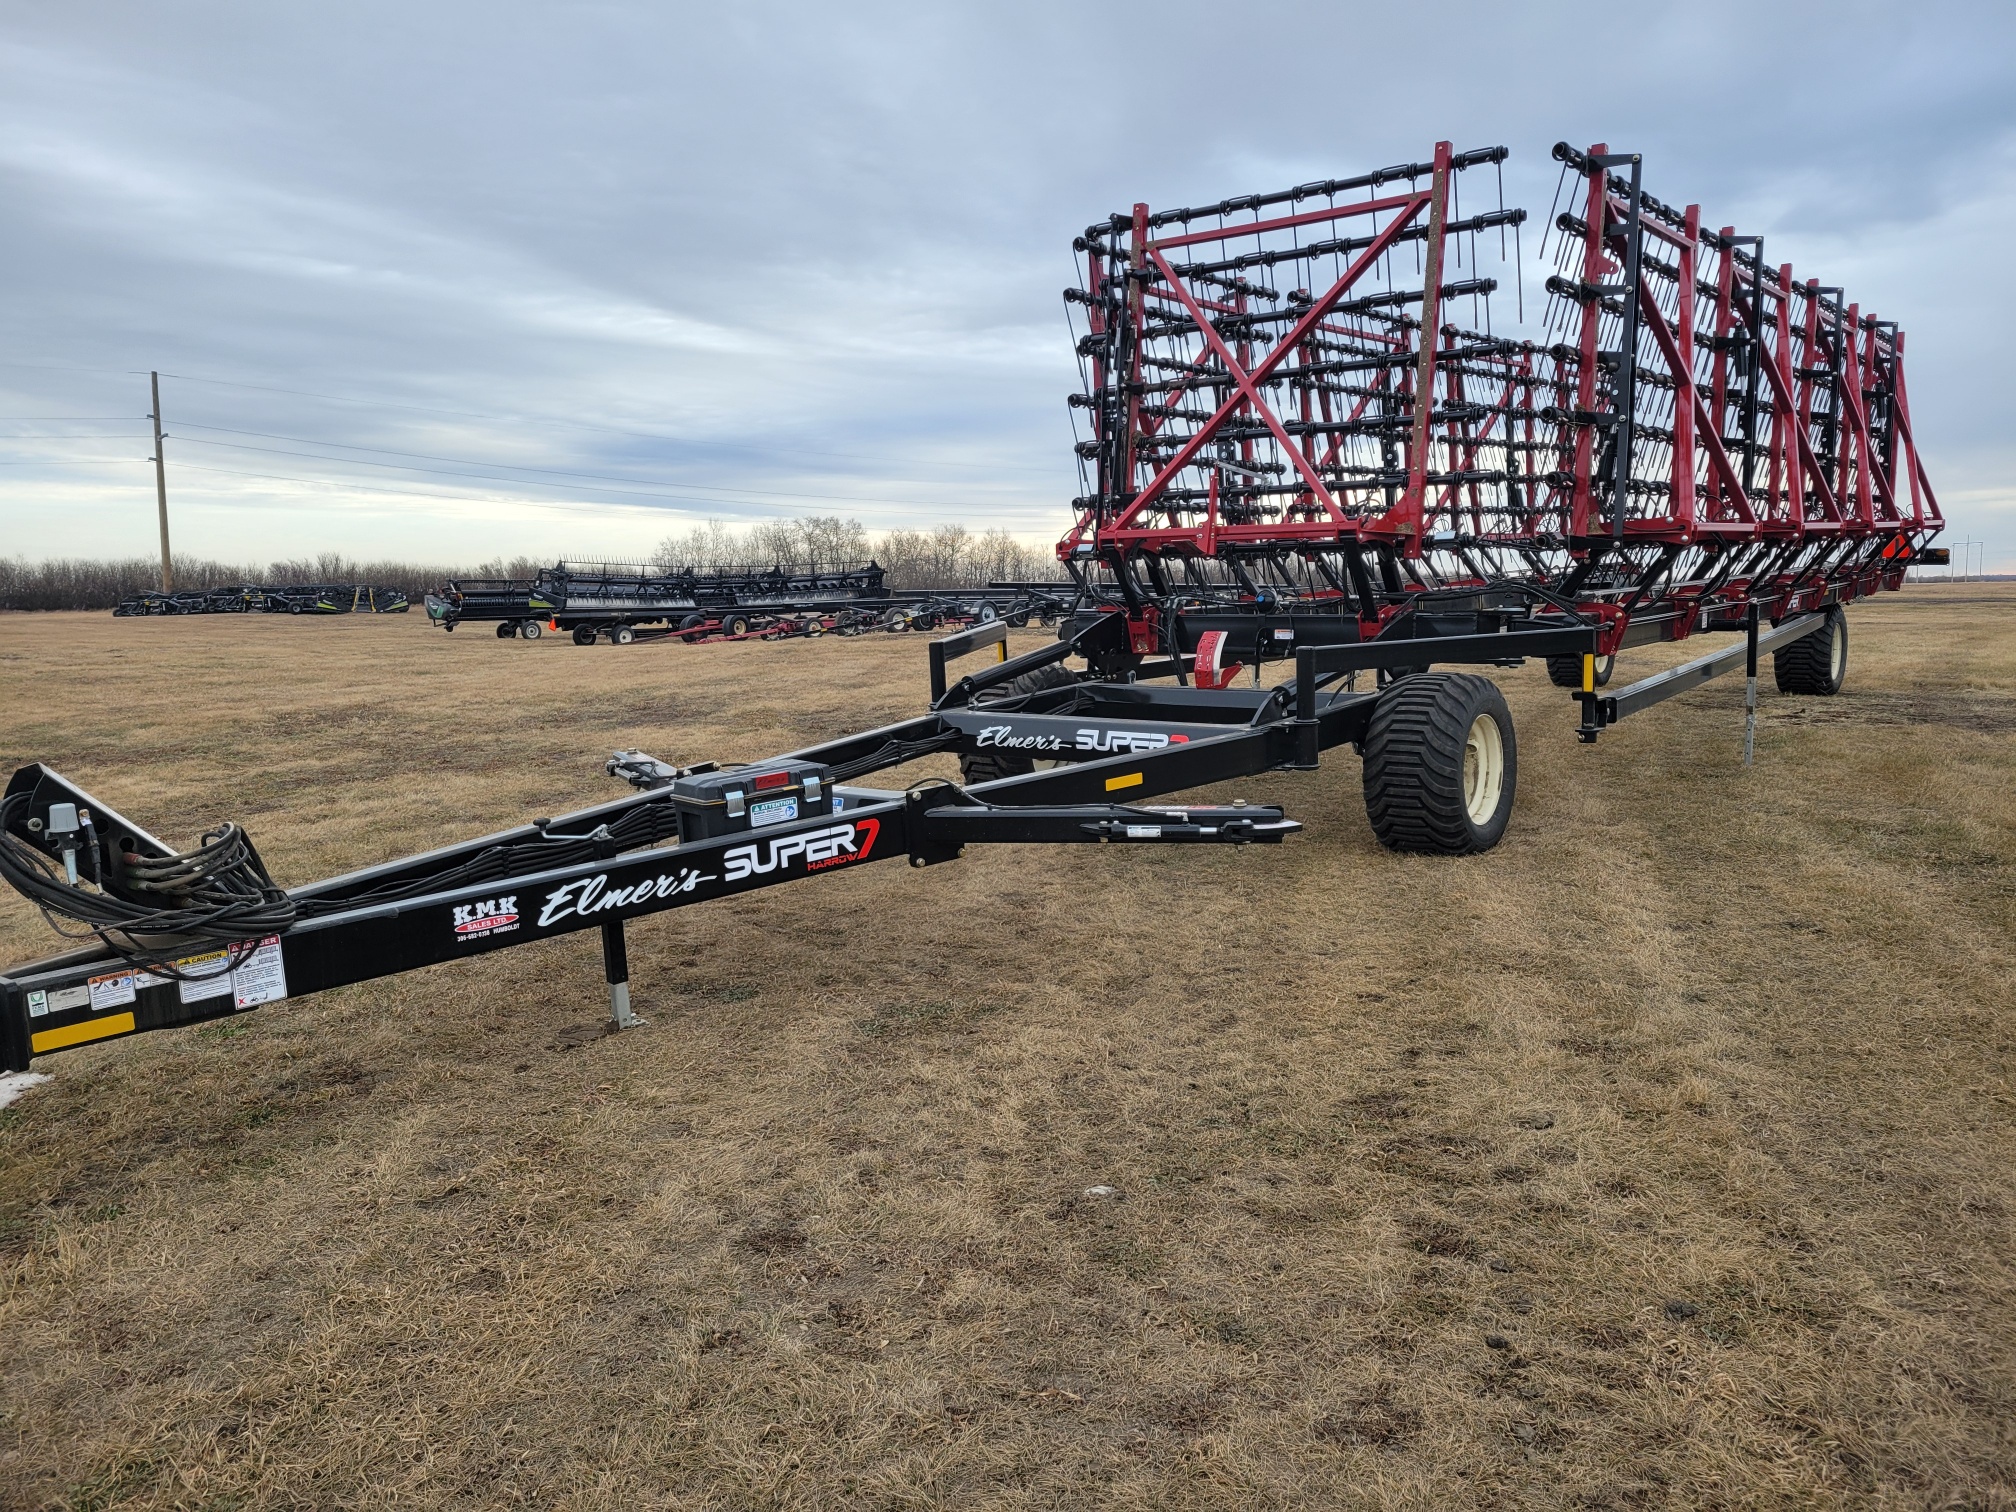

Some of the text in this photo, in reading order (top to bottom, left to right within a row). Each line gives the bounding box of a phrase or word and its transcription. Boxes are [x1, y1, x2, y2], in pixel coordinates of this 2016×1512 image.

[976, 725, 1072, 751] Elmer's
[760, 798, 795, 812] ATTENTION
[807, 853, 860, 872] HARROW
[537, 867, 718, 927] Elmer's
[467, 920, 491, 931] SALES
[493, 923, 520, 934] HUMBOLDT
[191, 952, 222, 963] CAUTION
[99, 971, 129, 981] WARNING
